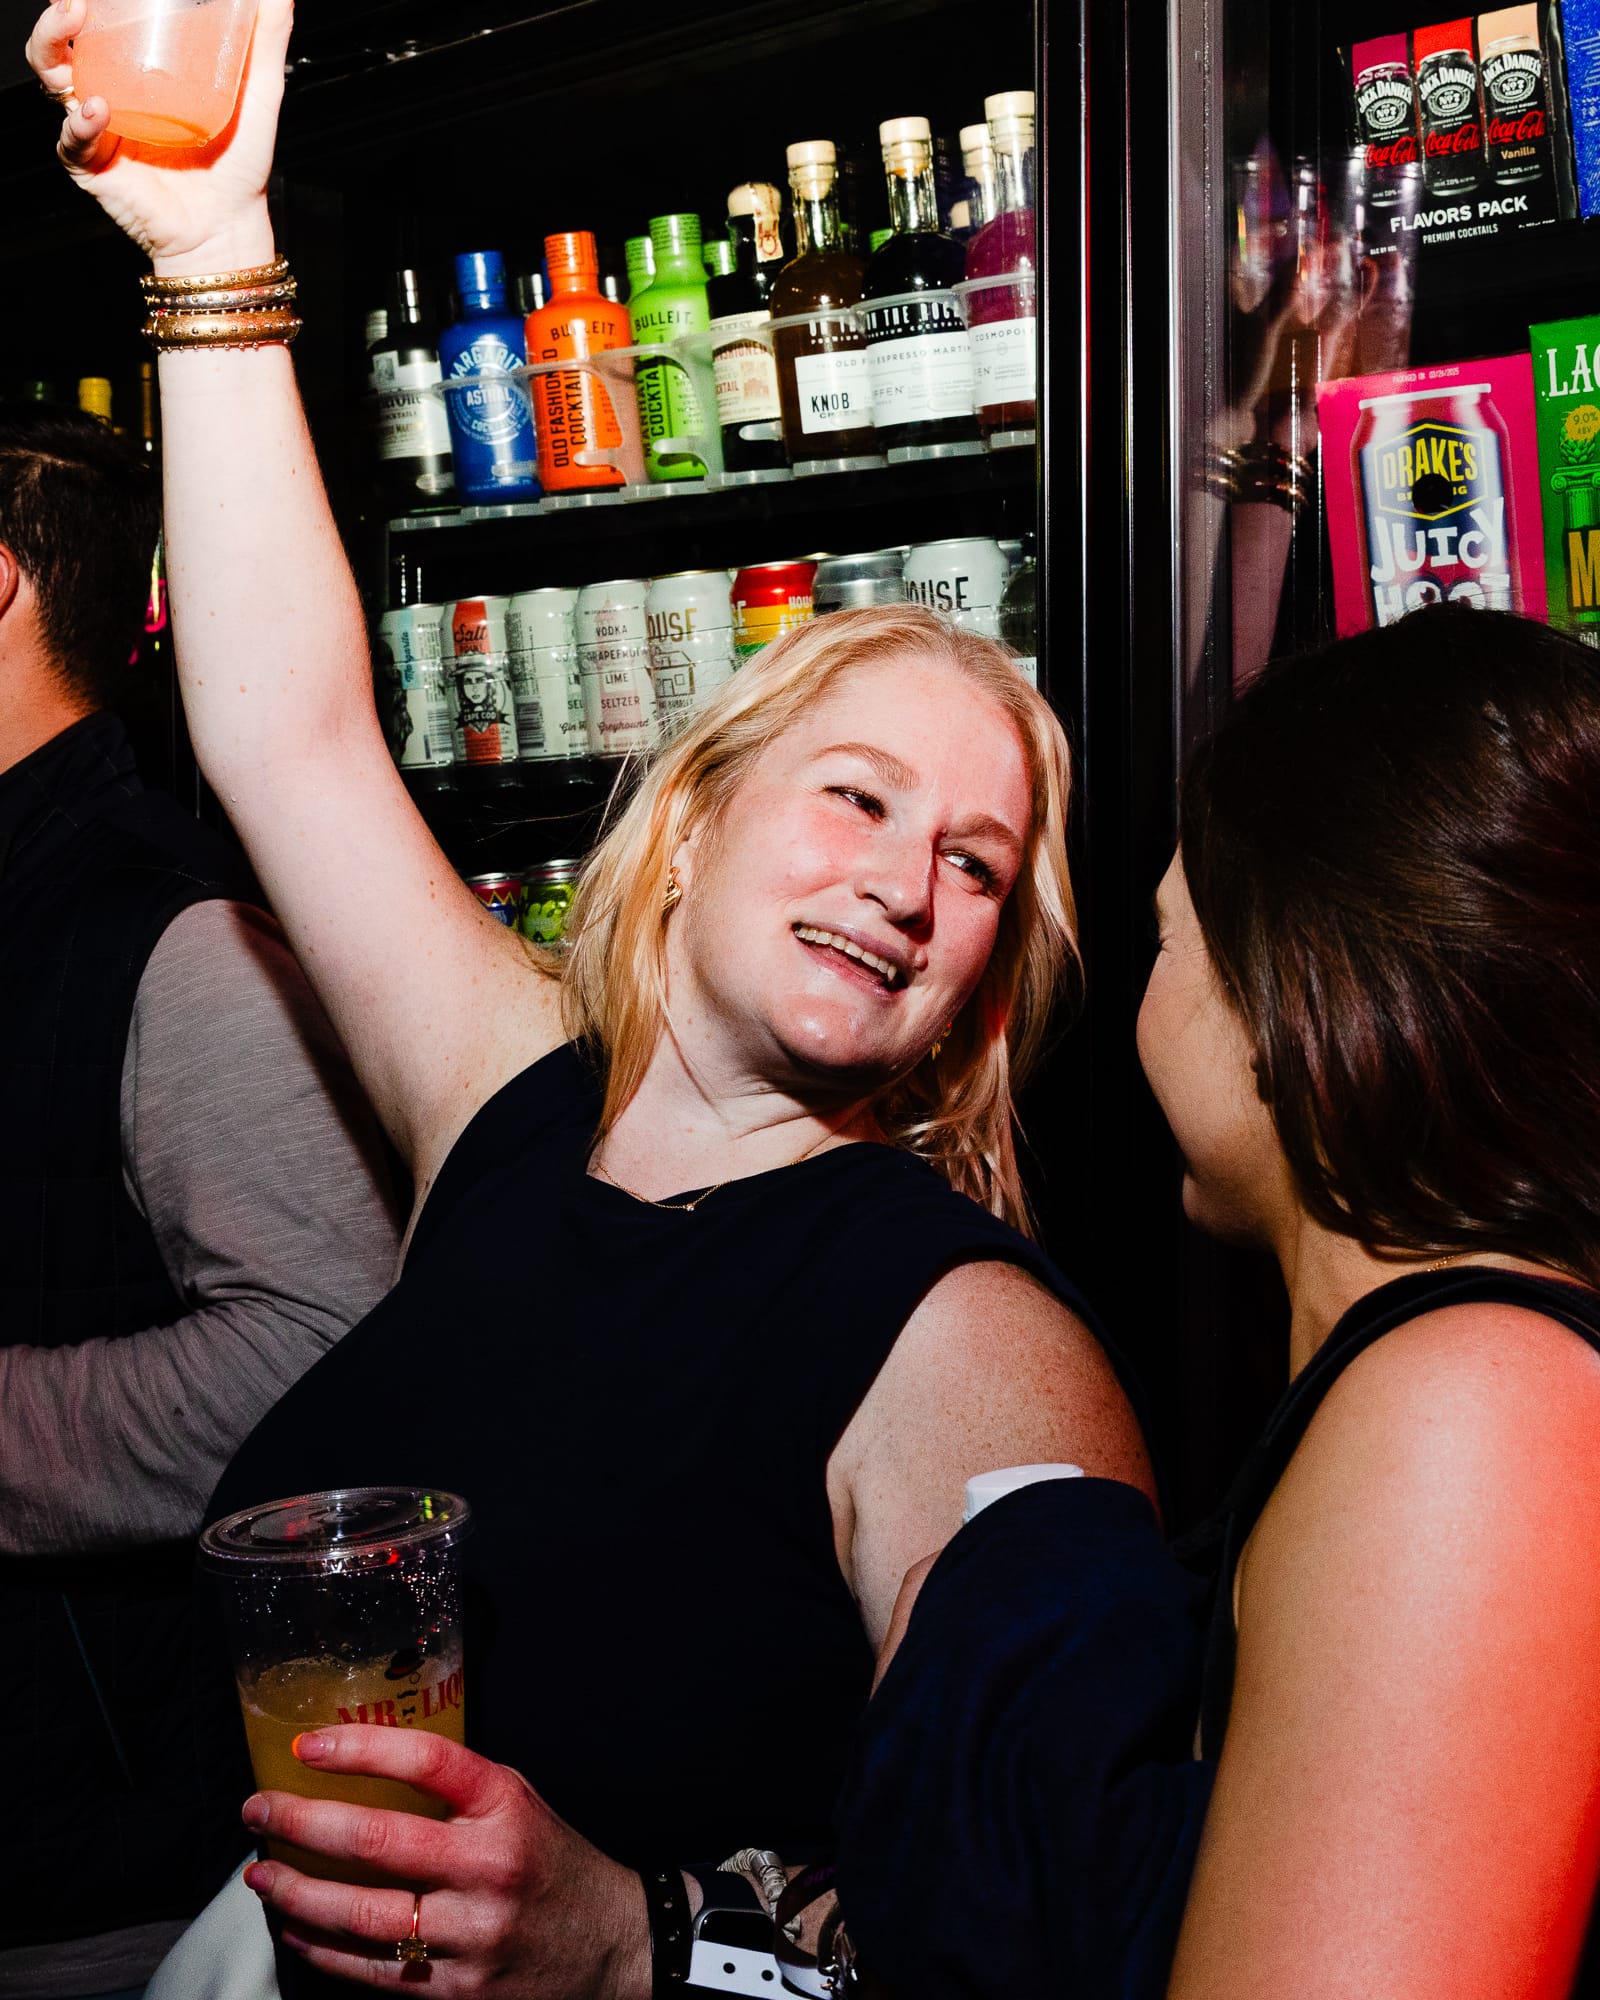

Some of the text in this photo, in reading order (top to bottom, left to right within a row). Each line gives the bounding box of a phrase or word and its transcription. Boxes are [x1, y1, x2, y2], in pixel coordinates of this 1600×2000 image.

[1482, 58, 1504, 88] JACK
[1419, 72, 1438, 101] JACK
[1358, 86, 1378, 114] JACK
[1501, 146, 1536, 160] Vanilla
[1390, 195, 1529, 233] FLAVORS PACK
[1422, 223, 1499, 244] PREMIUM COCKTAILS
[635, 311, 691, 331] BULLEIT
[883, 305, 910, 327] THE
[542, 348, 570, 468] OLD FASHIOND
[811, 393, 850, 413] KNOB
[1382, 437, 1478, 490] DRAKE'S
[1370, 496, 1505, 582] JUICY
[454, 623, 487, 643] Salt
[596, 625, 628, 637] VODKA
[605, 673, 628, 684] LIME
[601, 696, 640, 709] SELTZER
[464, 710, 497, 721] CAPE COD
